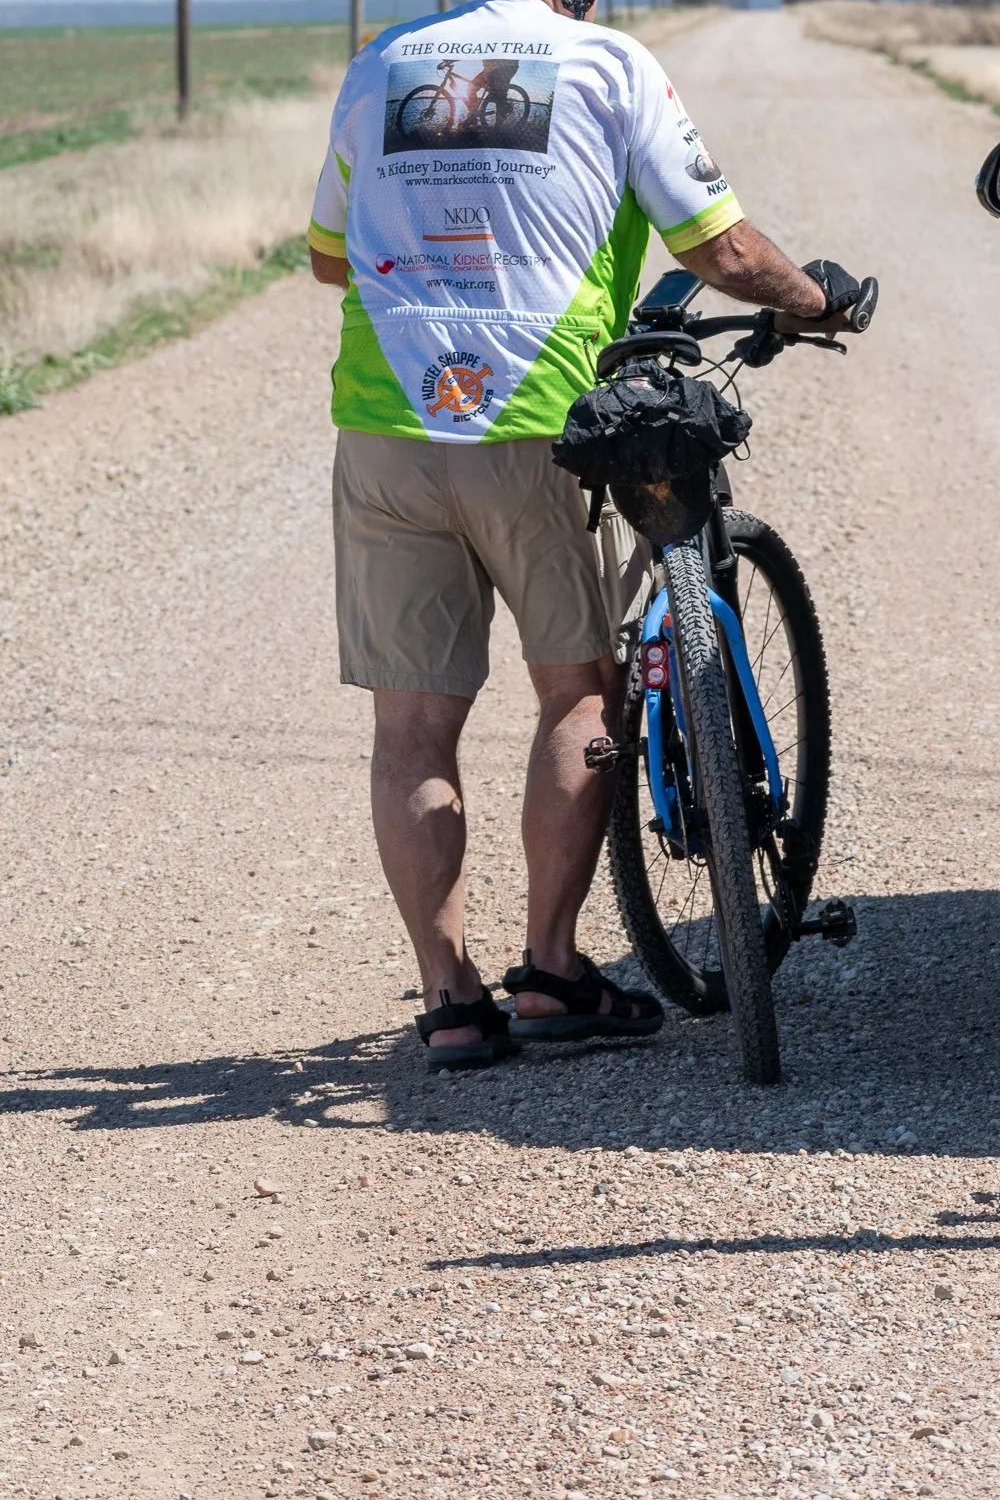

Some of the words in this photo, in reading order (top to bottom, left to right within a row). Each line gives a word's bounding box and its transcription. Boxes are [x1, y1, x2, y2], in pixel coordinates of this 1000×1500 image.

[401, 43, 434, 56] THE
[437, 42, 498, 54] ORGAN
[501, 42, 553, 56] TRAIL
[388, 161, 429, 177] Kidney
[433, 159, 491, 172] Donation
[495, 159, 556, 180] Journey"
[405, 174, 514, 186] www.markscotch.com
[443, 206, 491, 225] NKDO
[396, 253, 449, 266] NATIONAL
[453, 253, 490, 266] KIDNEY
[426, 278, 496, 292] www.nkr.org
[422, 364, 442, 401] HOSTEL
[438, 351, 480, 368] SHOPPE
[453, 389, 494, 422] BICYCLES
